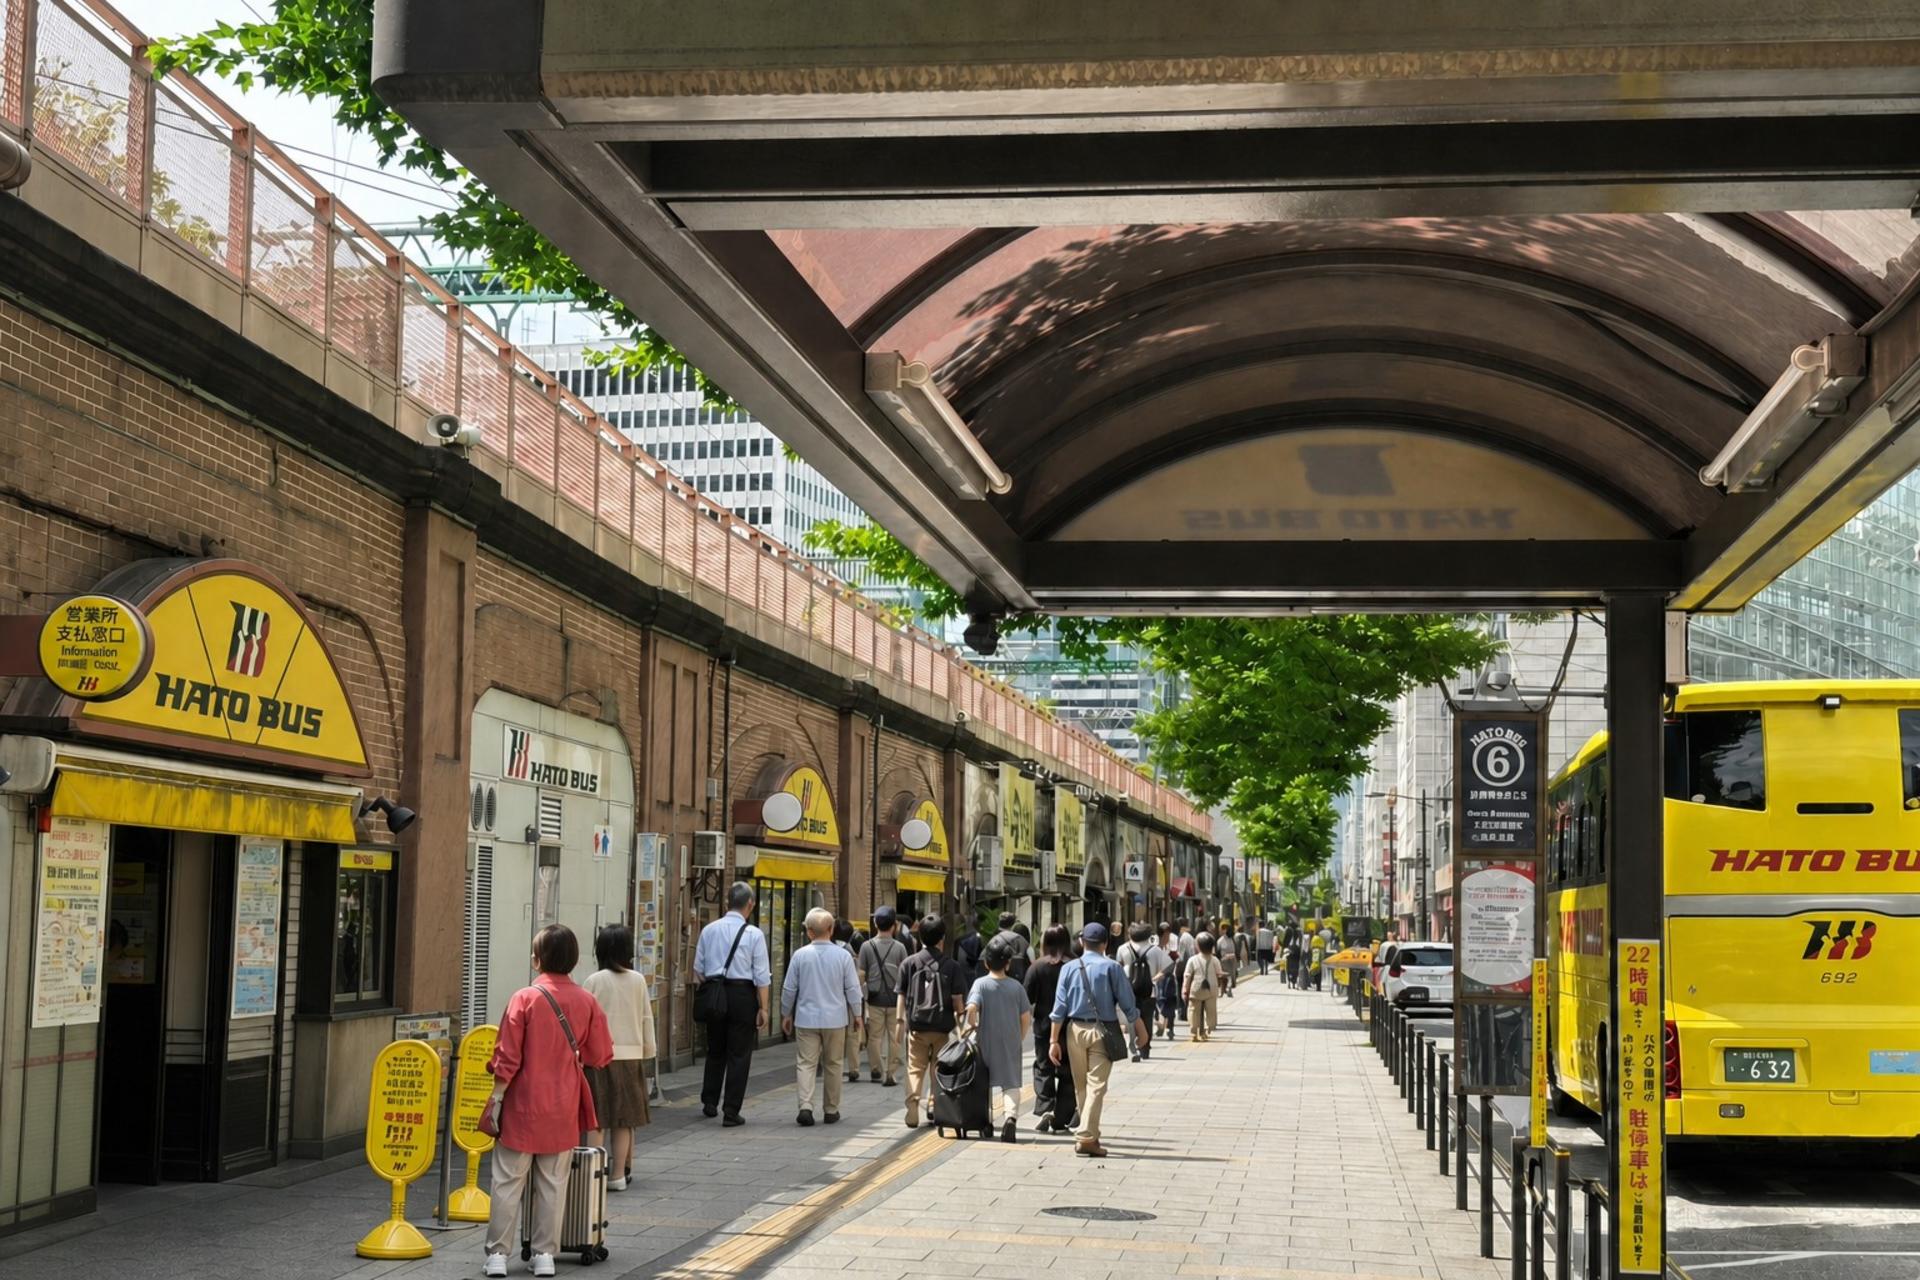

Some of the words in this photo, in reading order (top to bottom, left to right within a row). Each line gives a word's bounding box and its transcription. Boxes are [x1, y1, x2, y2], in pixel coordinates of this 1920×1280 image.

[66, 606, 119, 624] 営業所
[61, 645, 118, 657] Information
[155, 672, 251, 723] HATO
[258, 695, 324, 738] BUS
[1487, 746, 1510, 778] 6
[530, 762, 569, 787] HATO
[571, 770, 598, 793] BUS
[1709, 849, 1846, 872] HATO
[1820, 972, 1858, 984] 692
